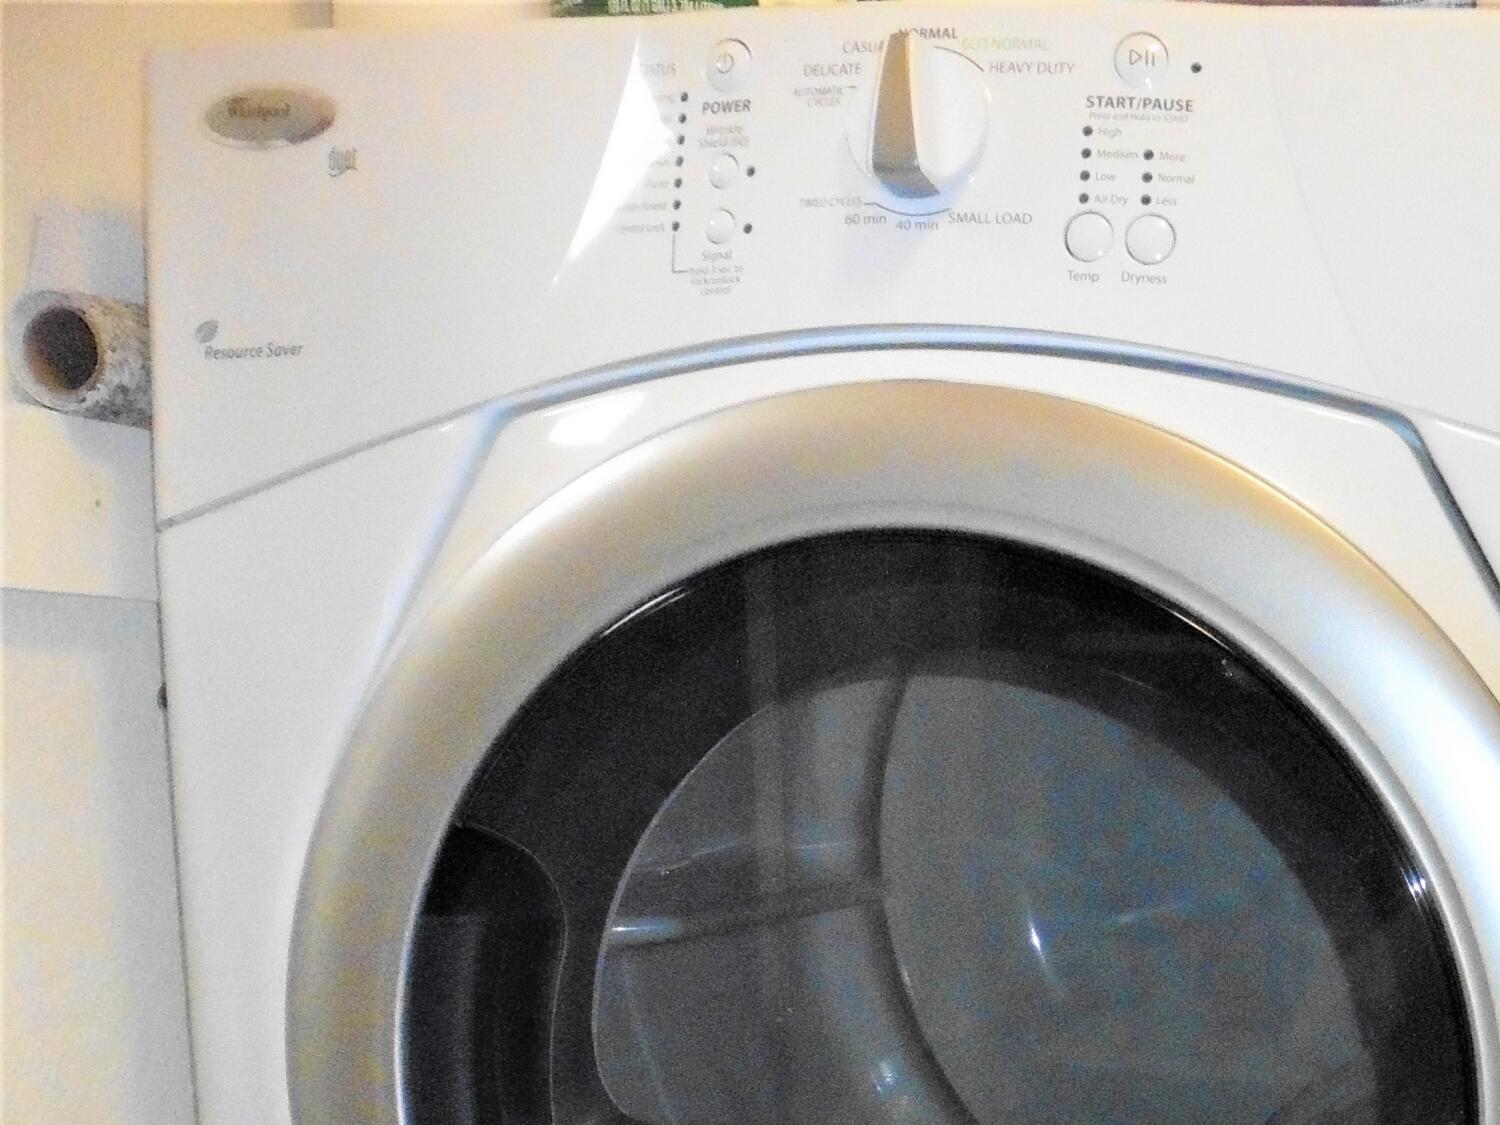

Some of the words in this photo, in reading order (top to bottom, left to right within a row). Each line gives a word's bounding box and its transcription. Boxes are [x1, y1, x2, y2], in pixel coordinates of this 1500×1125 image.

[841, 40, 882, 54] CASU
[961, 37, 989, 50] ECO
[991, 37, 1048, 51] NORMAL
[802, 62, 863, 78] DELICATE
[989, 61, 1032, 74] HEAVY
[1036, 61, 1076, 74] DUTY
[701, 98, 752, 115] POWER
[1085, 95, 1195, 113] START/PAUSE
[1097, 127, 1123, 139] High
[1096, 148, 1139, 160] Medium
[1159, 151, 1186, 162] More
[1095, 172, 1118, 182] Low
[1158, 172, 1195, 185] Normal
[1094, 194, 1108, 204] Air
[1110, 193, 1129, 207] Dry
[1156, 195, 1178, 206] Less
[845, 214, 861, 226] 60
[863, 213, 888, 226] min
[947, 210, 991, 226] SMALL
[995, 210, 1034, 226] LOAD
[896, 219, 912, 231] 40
[914, 219, 940, 232] min
[701, 248, 733, 263] Signal
[1066, 269, 1101, 284] Temp
[1120, 270, 1168, 285] Dryness
[203, 344, 264, 360] Resource
[266, 341, 305, 358] Saver
